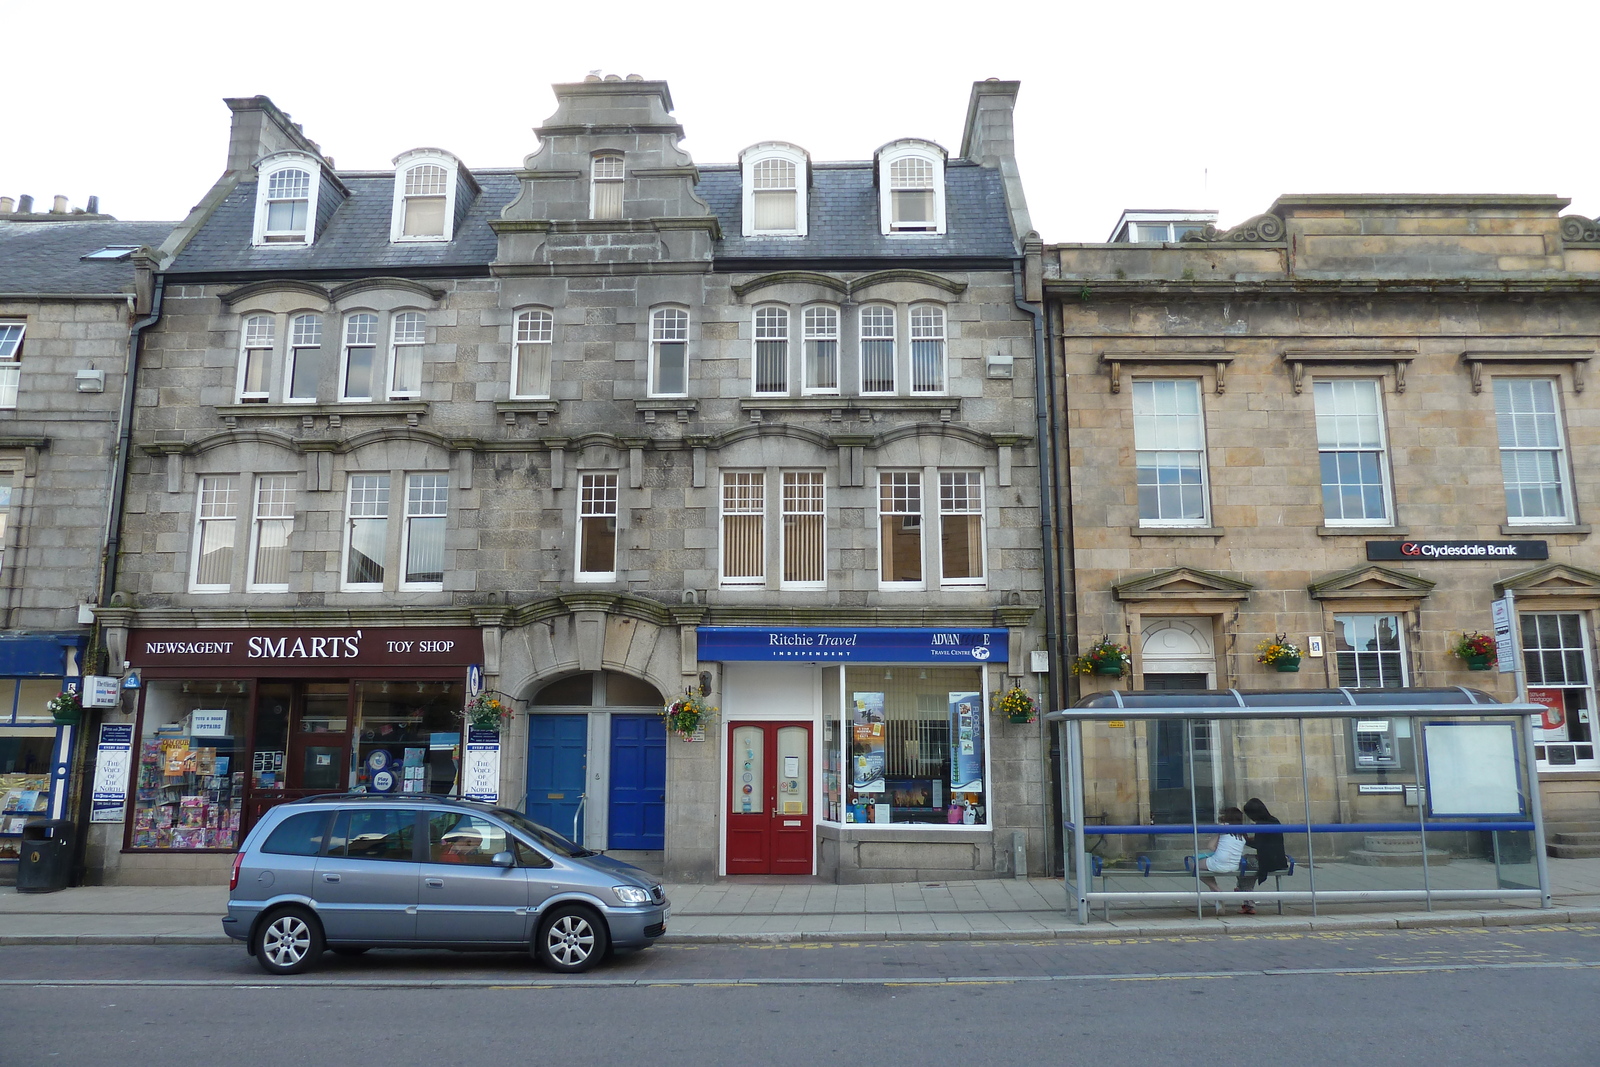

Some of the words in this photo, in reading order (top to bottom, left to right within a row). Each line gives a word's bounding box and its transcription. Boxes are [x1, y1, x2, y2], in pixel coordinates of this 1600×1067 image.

[1422, 545, 1486, 557] Clydesdale
[1488, 545, 1516, 555] Bank
[146, 642, 233, 654] NEWSAGENT
[248, 630, 362, 658] SMARTS'
[387, 641, 414, 653] TOY
[419, 640, 454, 652] SHOP
[769, 633, 813, 646] Ritchie
[817, 634, 857, 646] Travel
